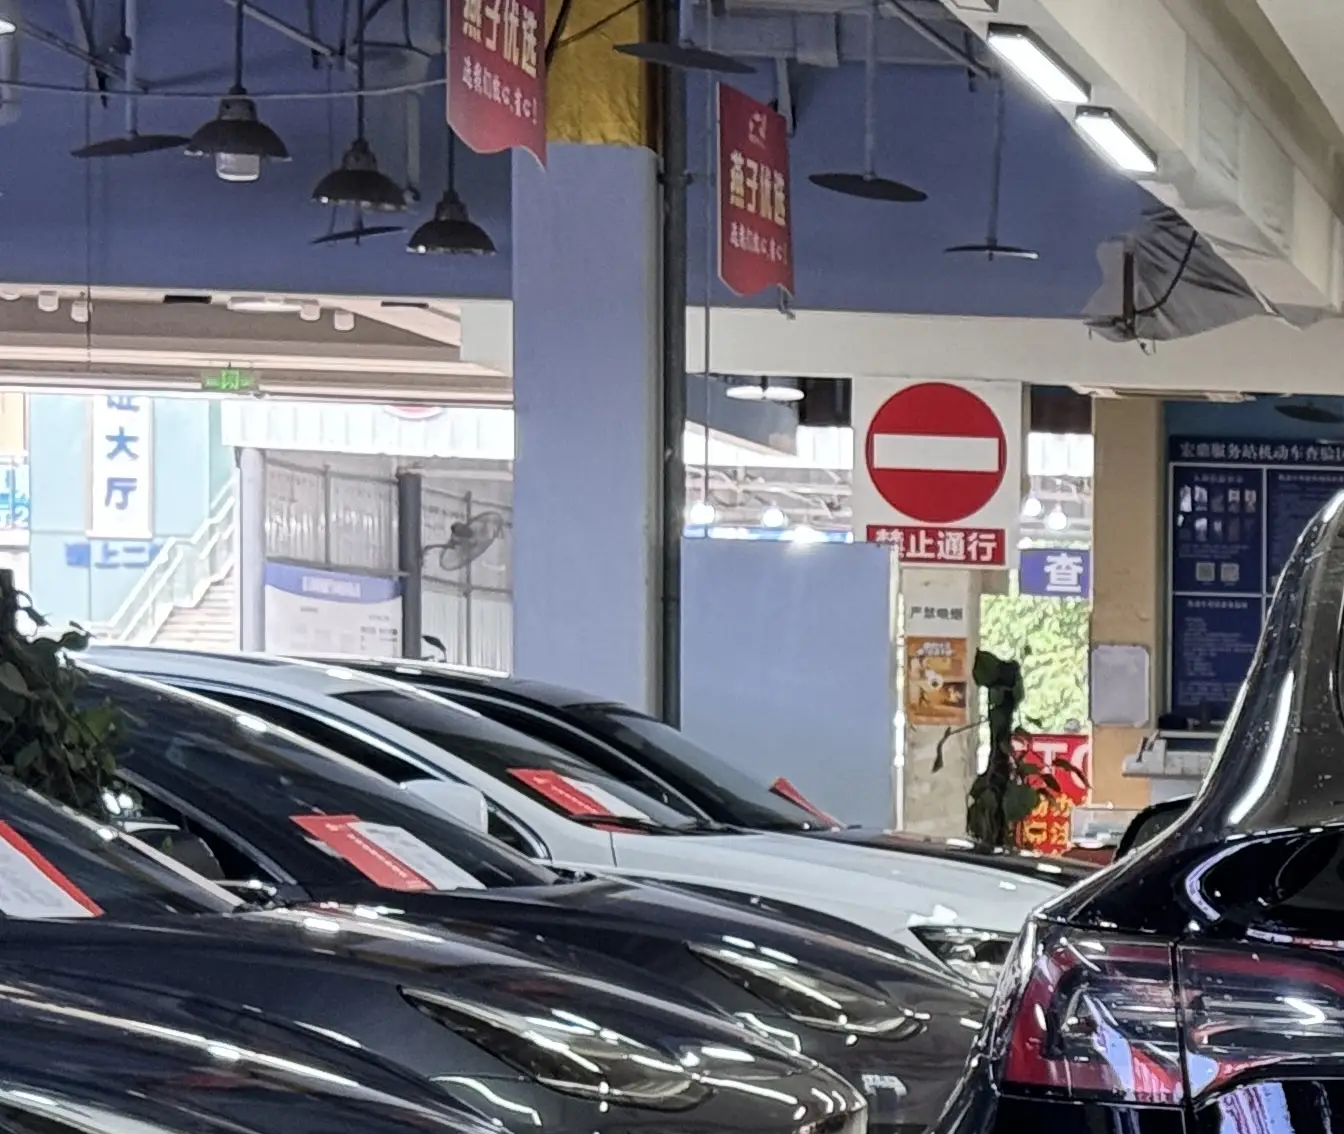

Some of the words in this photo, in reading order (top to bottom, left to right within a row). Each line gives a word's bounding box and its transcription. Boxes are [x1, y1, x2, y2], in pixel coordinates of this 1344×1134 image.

[463, 0, 537, 78] 燕子优选
[730, 150, 786, 227] 燕子优选
[875, 528, 997, 562] 禁止通行
[1044, 552, 1083, 593] 查
